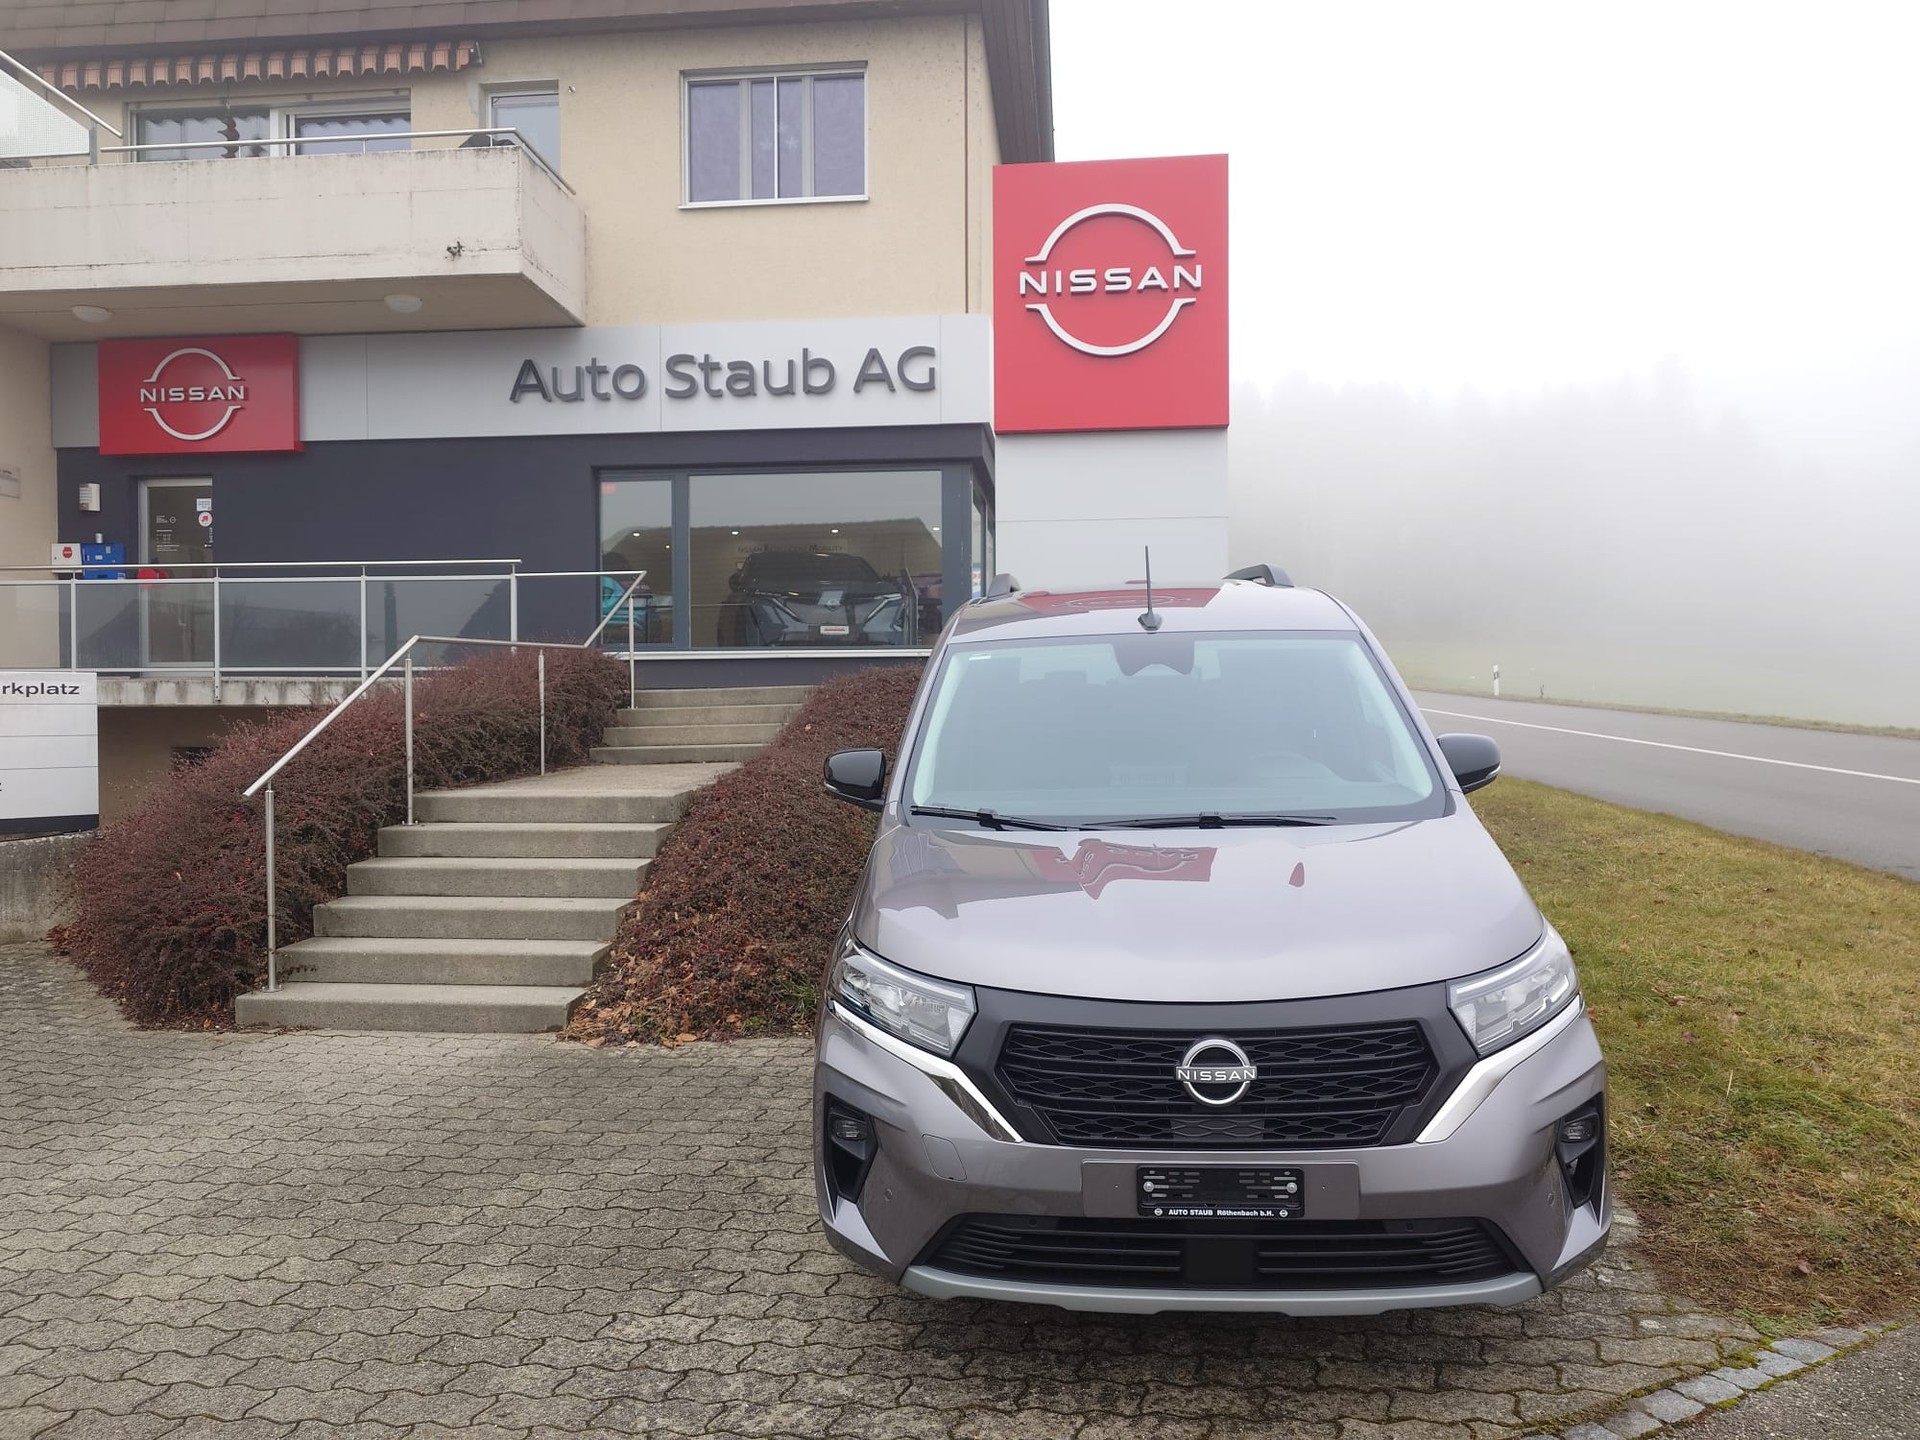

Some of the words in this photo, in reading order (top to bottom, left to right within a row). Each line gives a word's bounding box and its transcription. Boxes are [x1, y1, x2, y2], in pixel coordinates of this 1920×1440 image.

[1019, 264, 1202, 296] NISSAN
[509, 357, 647, 403] Auto
[665, 347, 837, 398] Staub
[853, 346, 936, 392] AG
[140, 385, 245, 403] NISSAN
[1177, 1068, 1256, 1081] NISSAN
[1216, 1209, 1259, 1217] Röthenbach
